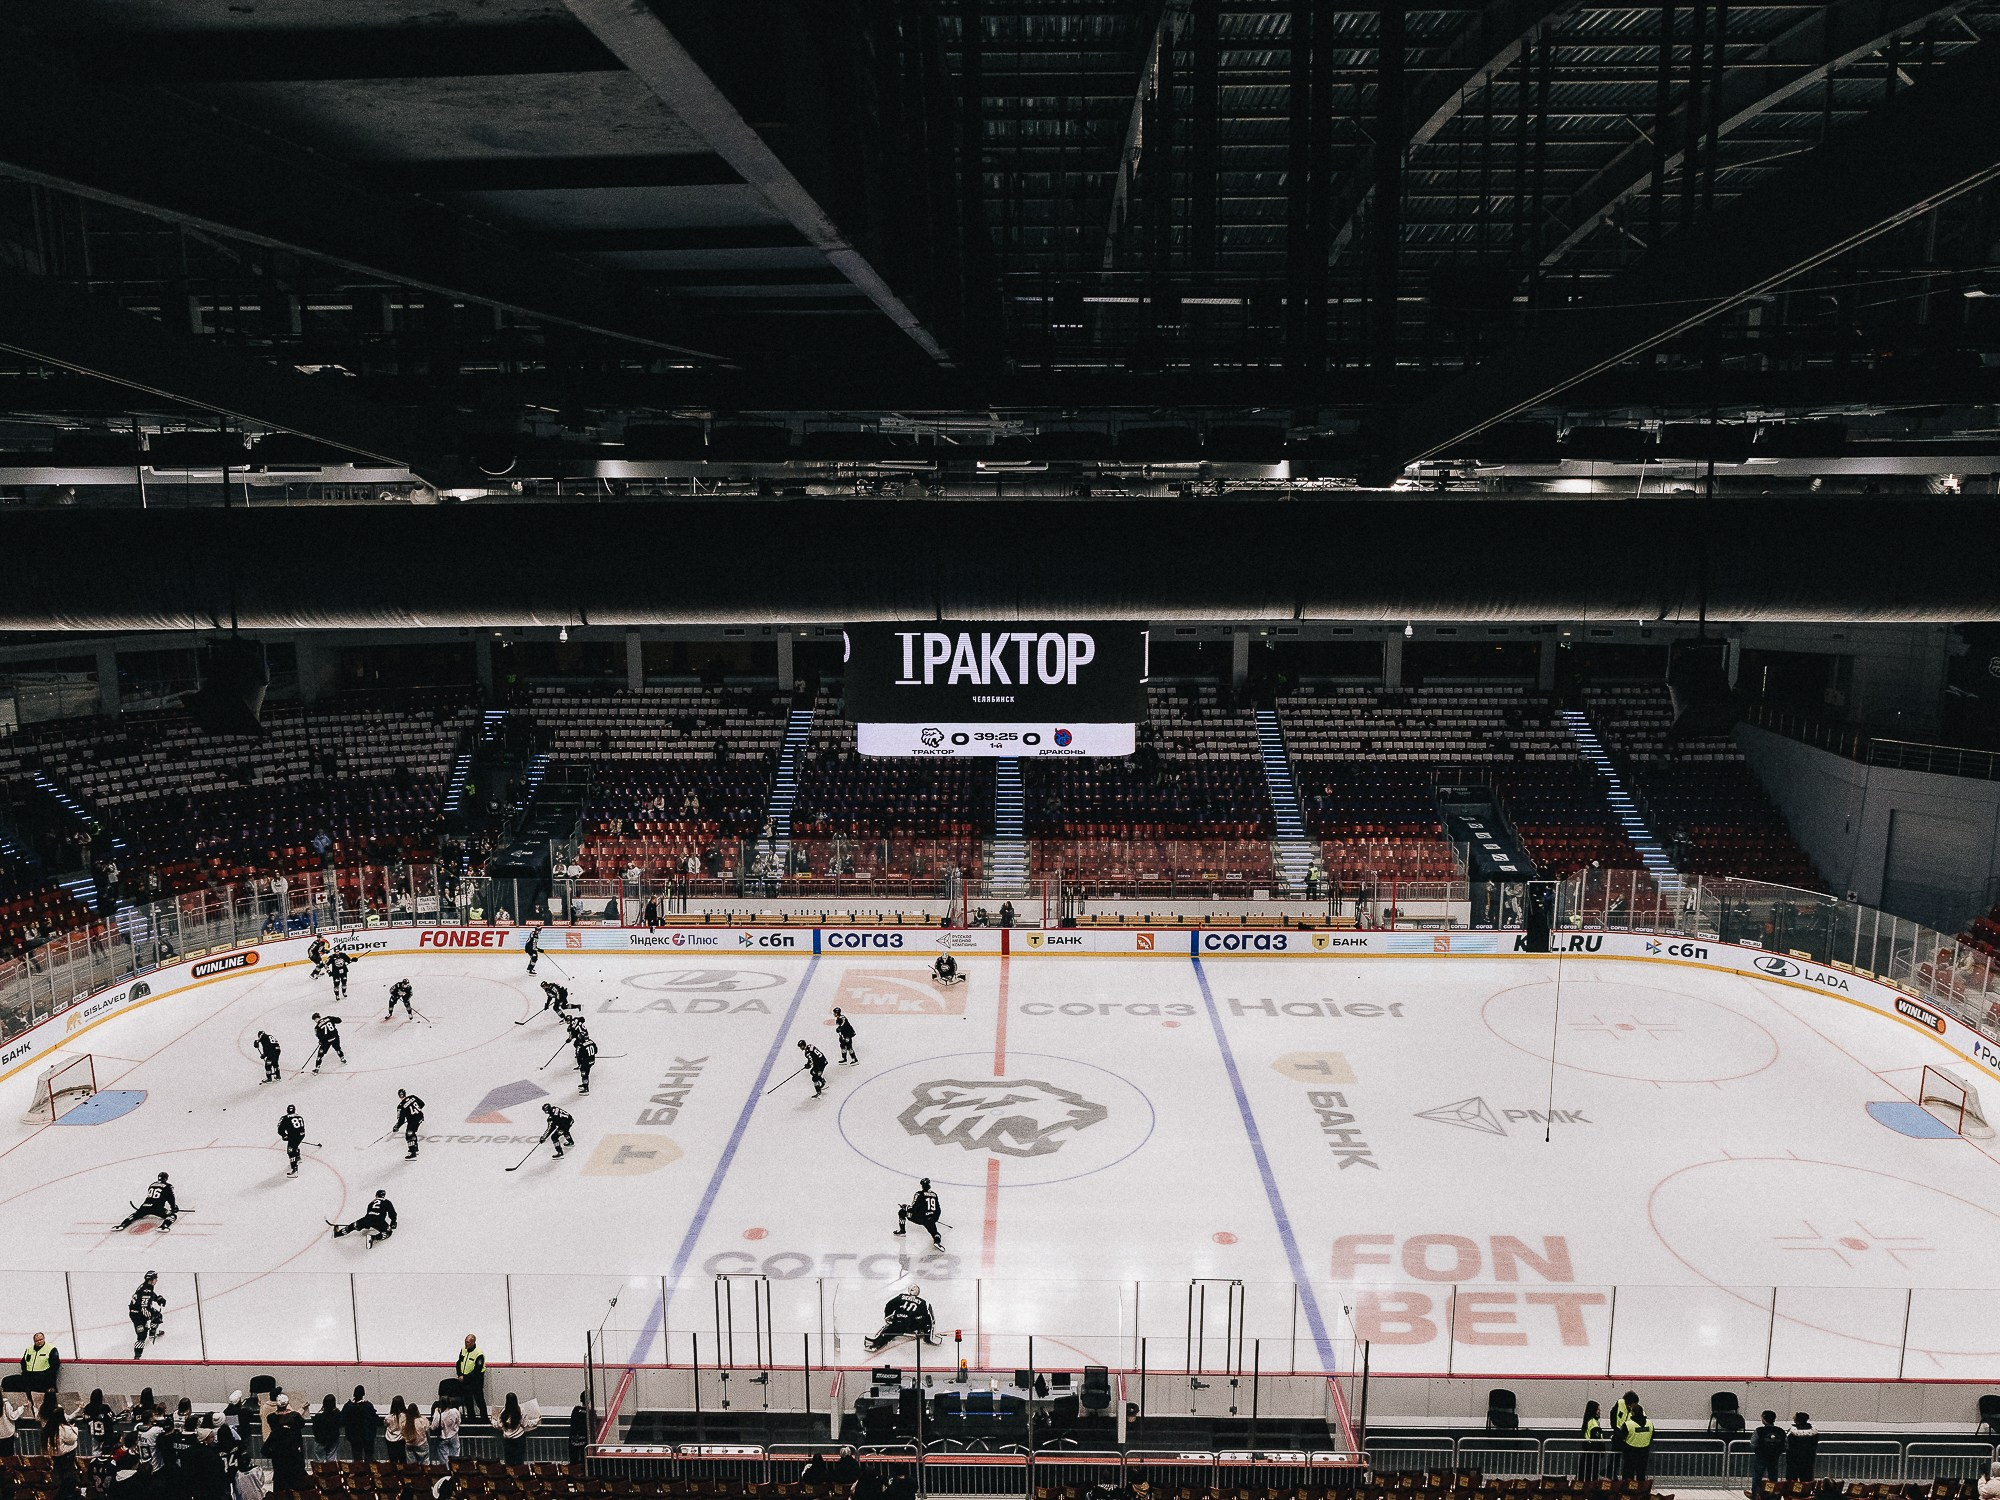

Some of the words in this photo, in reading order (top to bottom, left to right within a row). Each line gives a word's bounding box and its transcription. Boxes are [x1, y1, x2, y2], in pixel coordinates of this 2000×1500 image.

[895, 632, 1095, 685] ТРАКТОР
[974, 732, 1018, 741] 39:25
[420, 931, 509, 947] FONBET
[630, 934, 670, 947] Яндекс
[688, 934, 719, 945] Плюс
[759, 933, 795, 947] сбп
[1047, 936, 1083, 945] БАНК
[1332, 938, 1368, 947] БАНК
[1514, 935, 1603, 953] KL.RU
[1668, 943, 1708, 959] сбп
[195, 955, 245, 976] WINLINE
[1805, 968, 1849, 992] LADA
[83, 992, 126, 1018] GISLAVED
[597, 998, 772, 1014] LADA
[1228, 997, 1405, 1018] Haier
[1898, 1000, 1937, 1028] WINLINE
[1, 1041, 31, 1065] БАНК
[635, 1056, 710, 1126] БАНК
[1503, 1109, 1593, 1124] РМК
[1306, 1091, 1380, 1171] БАНК
[925, 1197, 936, 1210] 19
[1331, 1233, 1575, 1282] FON
[1355, 1290, 1607, 1347] BET
